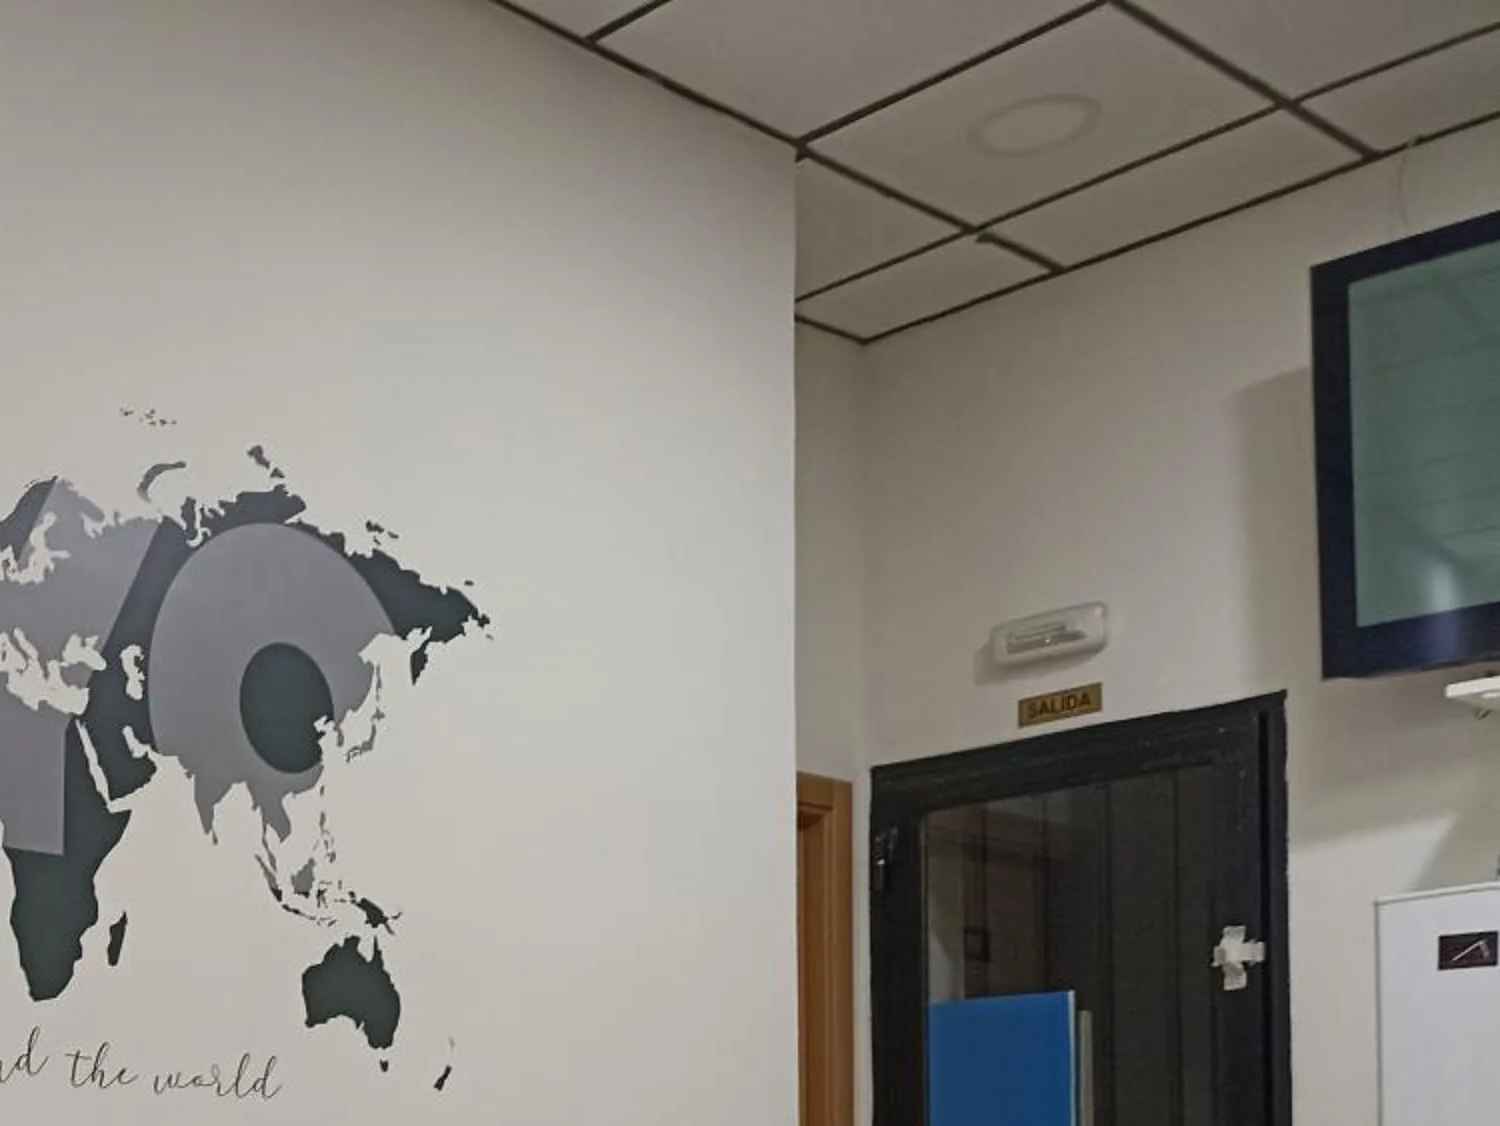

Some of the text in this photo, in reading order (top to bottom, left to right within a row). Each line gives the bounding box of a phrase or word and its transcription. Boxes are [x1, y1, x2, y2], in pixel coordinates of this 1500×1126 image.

[1027, 692, 1091, 719] SALIDA
[65, 1041, 139, 1089] the
[153, 1052, 281, 1100] world
